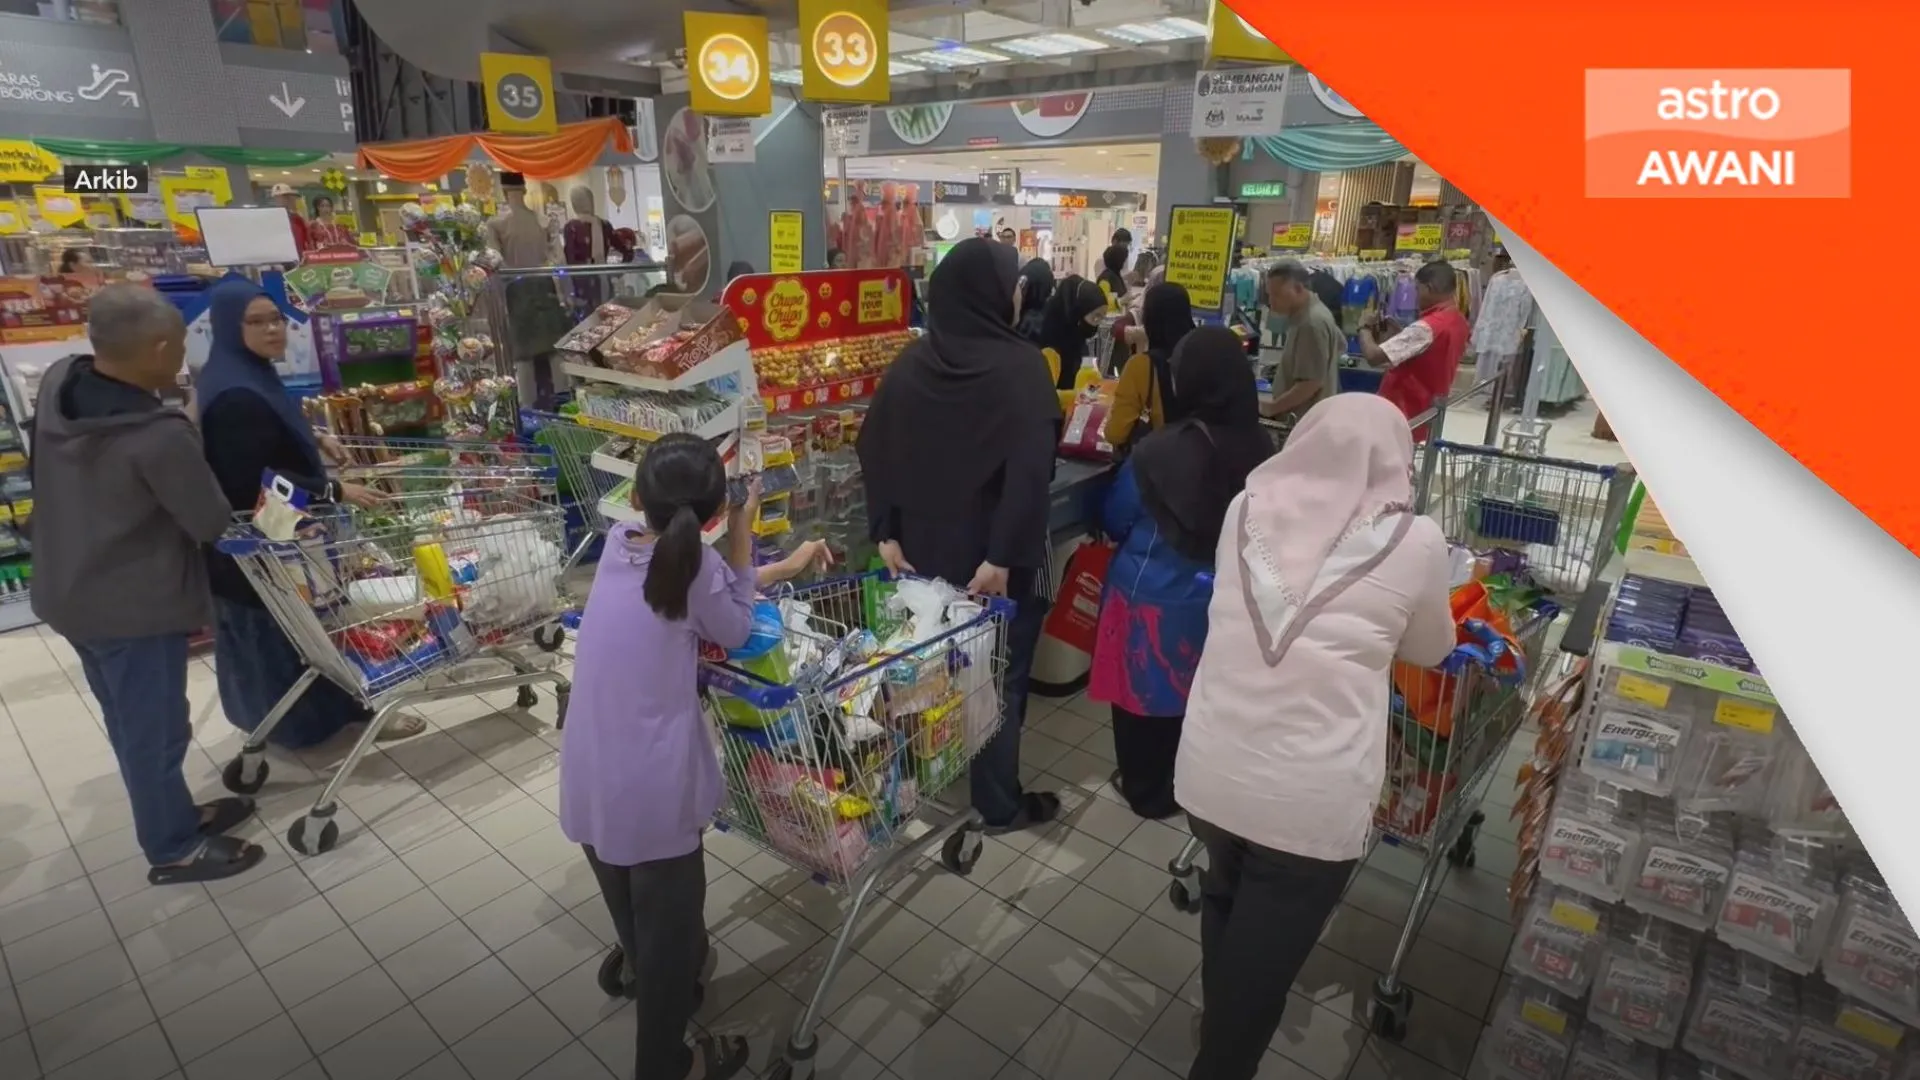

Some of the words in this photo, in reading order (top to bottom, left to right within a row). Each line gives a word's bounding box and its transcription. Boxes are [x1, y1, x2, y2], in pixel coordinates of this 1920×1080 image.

[823, 31, 868, 66] 33
[708, 51, 752, 83] 34
[502, 83, 538, 109] 35
[1174, 250, 1220, 261] KAUNTER
[1601, 722, 1677, 743] Energizer
[1554, 827, 1622, 851] Energizer
[1650, 856, 1725, 881] Energizer
[1733, 884, 1816, 916] Energizer
